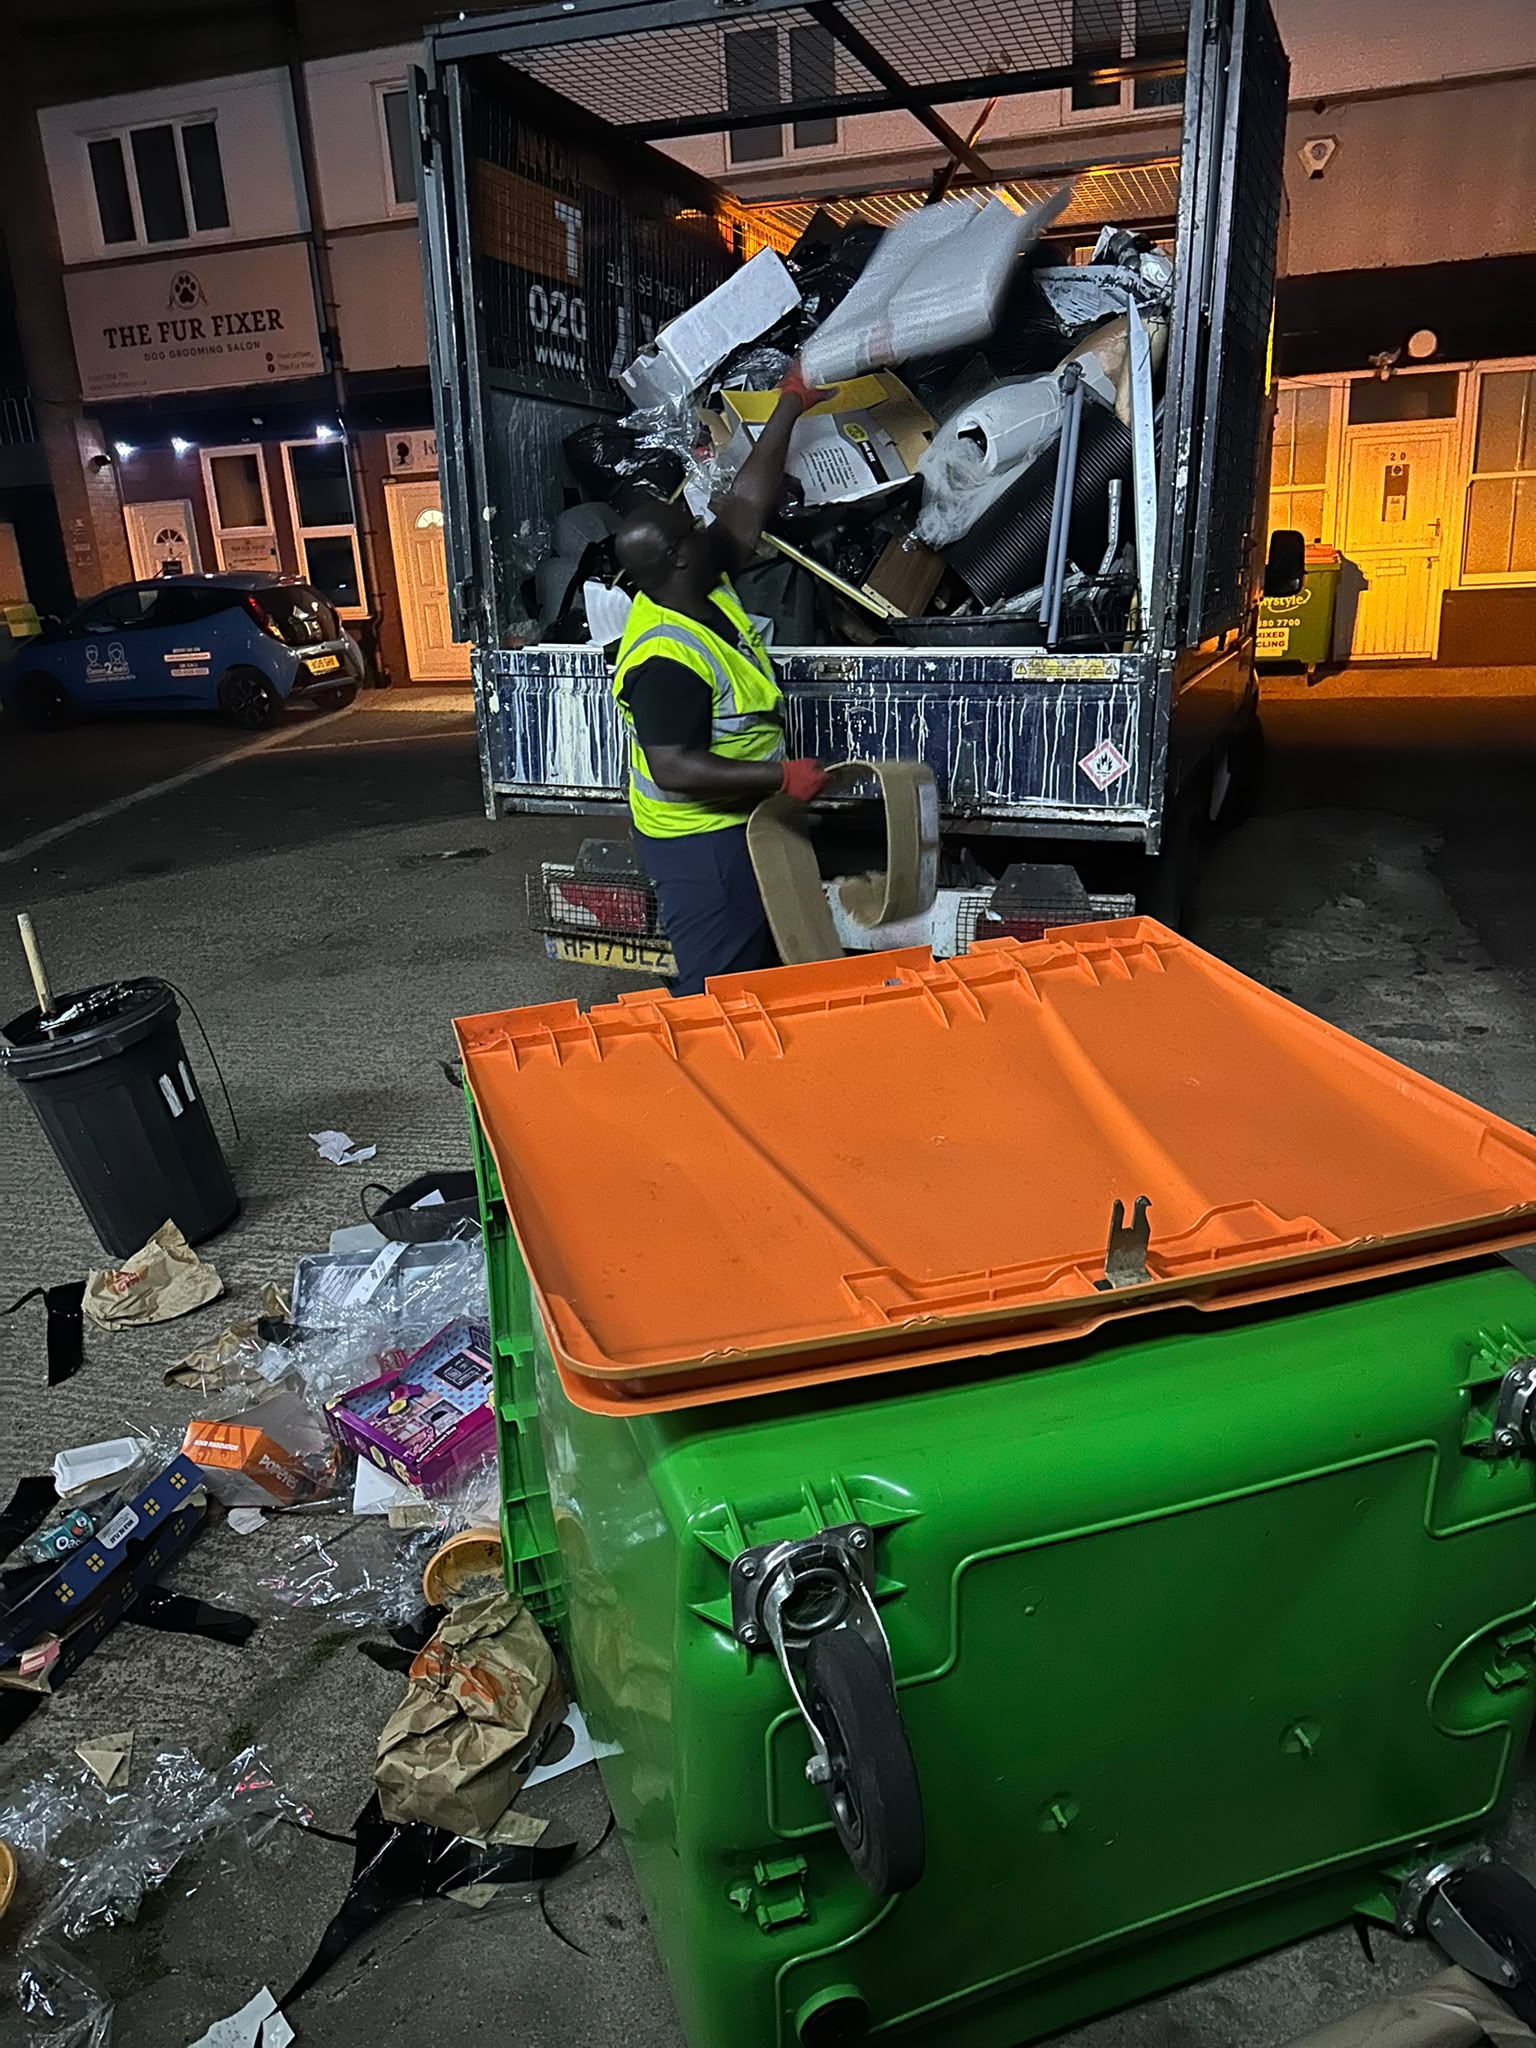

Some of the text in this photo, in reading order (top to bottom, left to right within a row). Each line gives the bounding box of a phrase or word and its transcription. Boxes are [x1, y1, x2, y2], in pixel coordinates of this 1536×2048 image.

[103, 309, 284, 350] THE FUR FIXER
[144, 340, 261, 362] DOG GROOMING SALON
[1276, 618, 1300, 626] 7700
